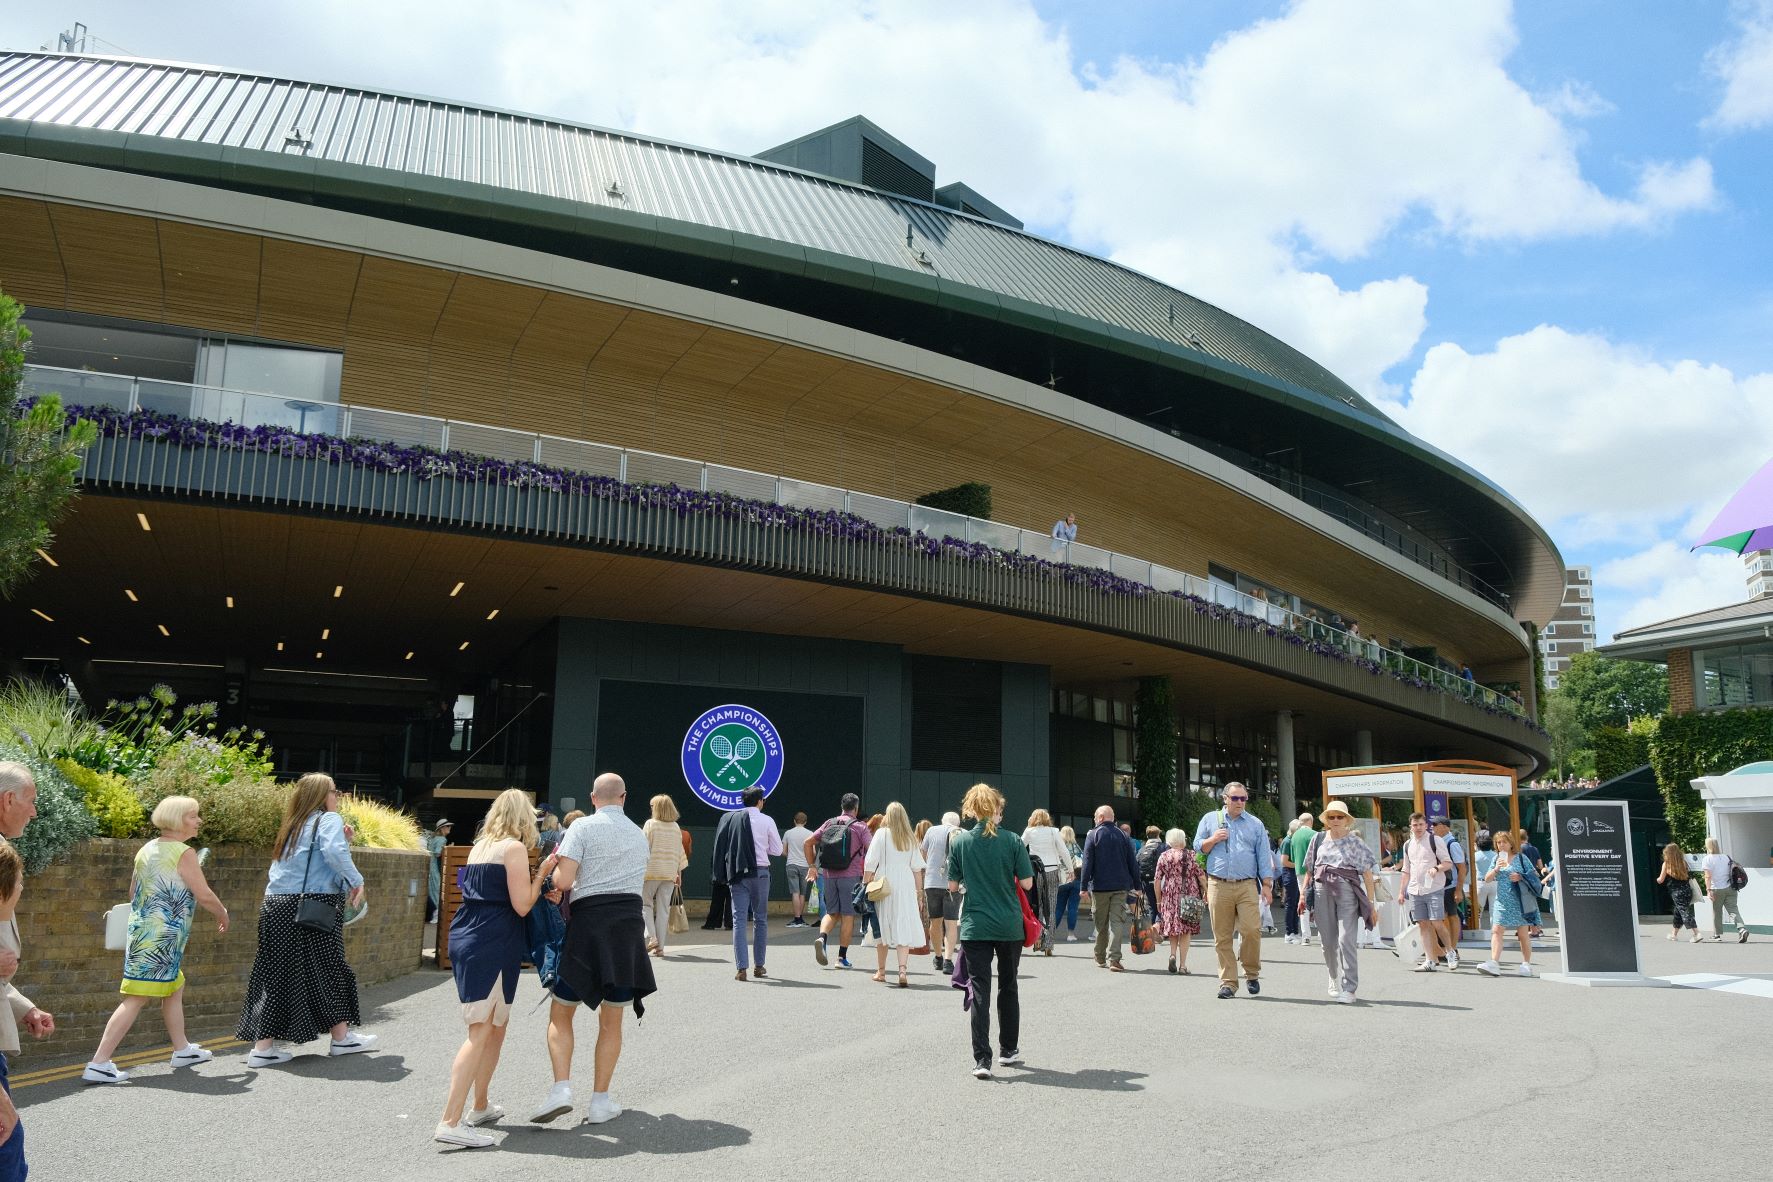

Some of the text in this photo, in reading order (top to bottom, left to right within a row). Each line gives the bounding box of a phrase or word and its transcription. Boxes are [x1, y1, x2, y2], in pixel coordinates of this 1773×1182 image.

[226, 688, 240, 704] 3
[688, 710, 778, 756] THE CHAMPIONSHIPS
[699, 781, 767, 805] WIMBLE
[1336, 779, 1404, 789] CHAMPIONSHIPS INFORMATION
